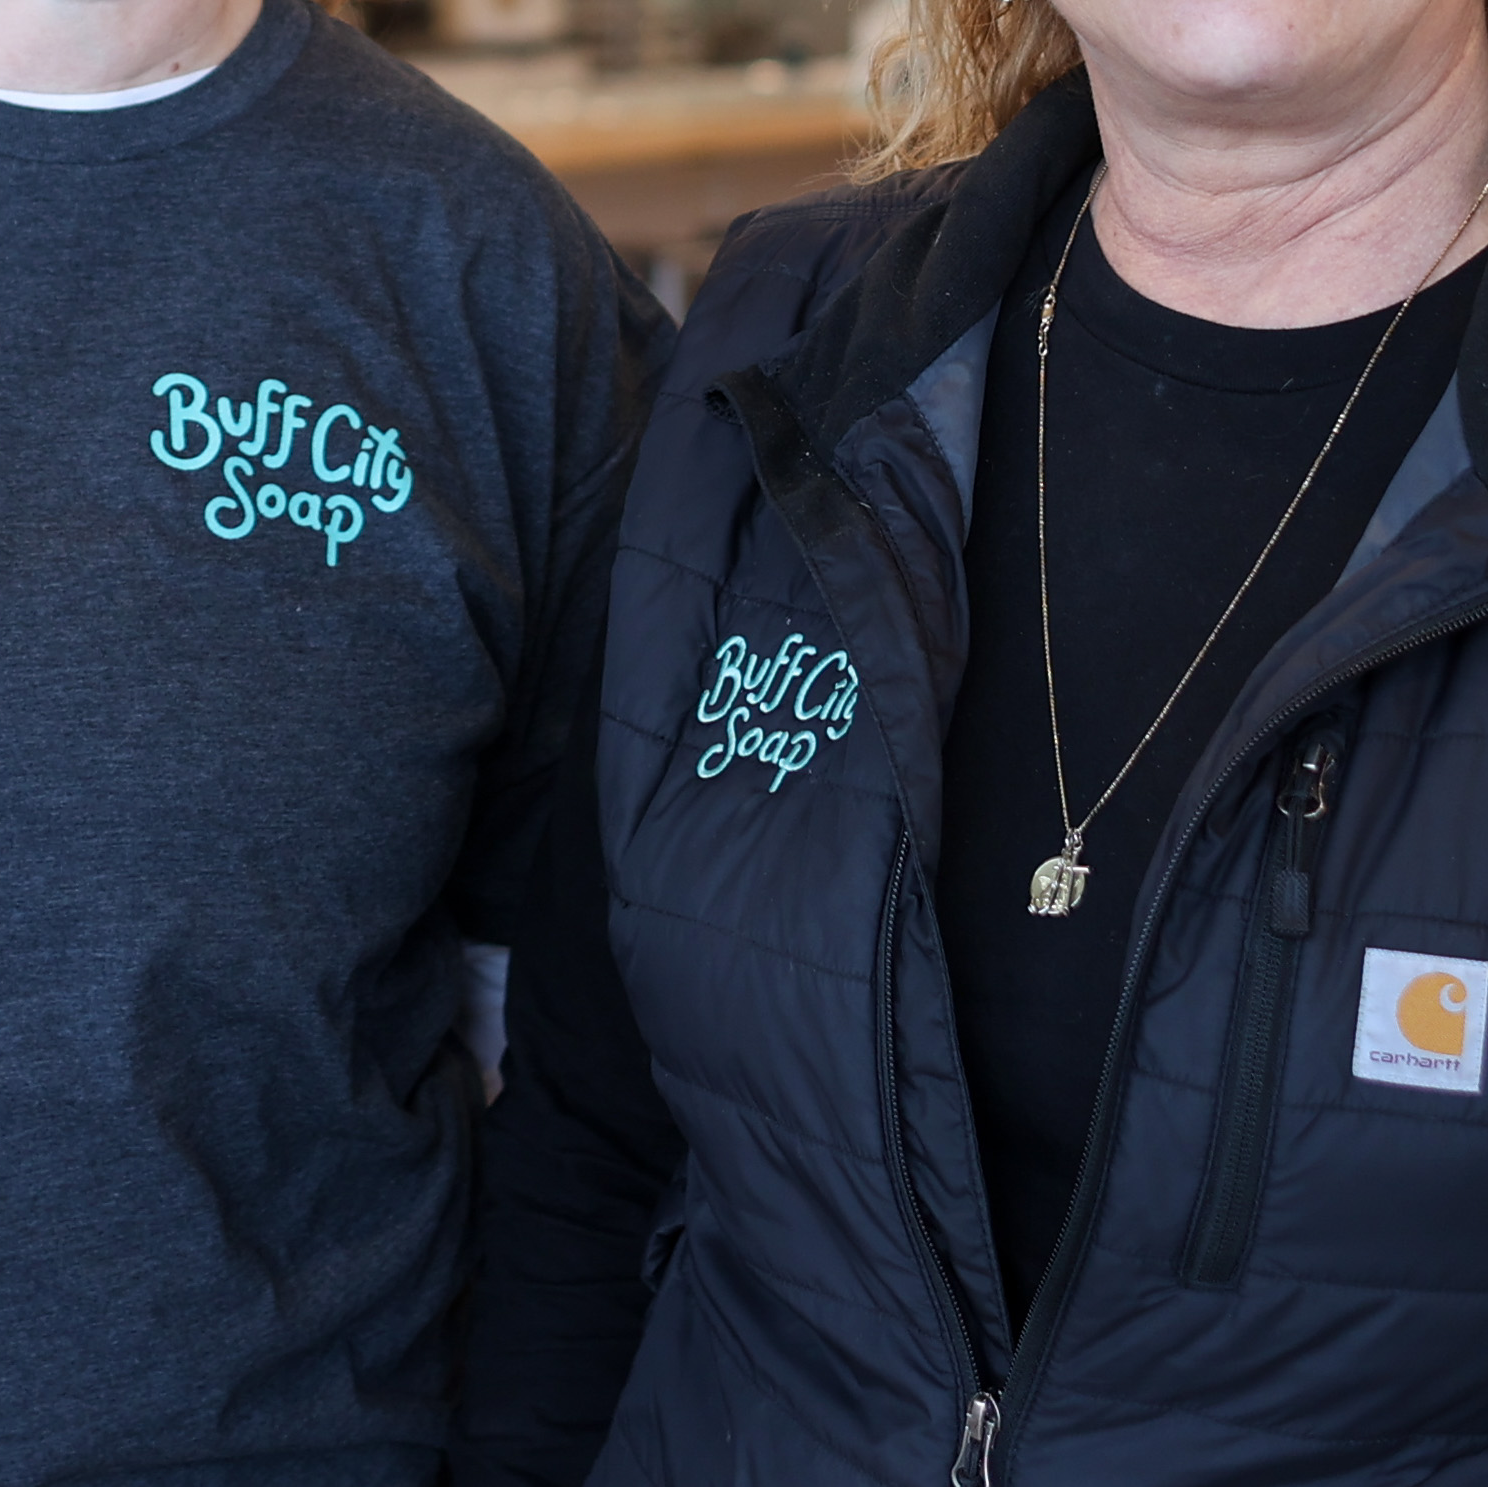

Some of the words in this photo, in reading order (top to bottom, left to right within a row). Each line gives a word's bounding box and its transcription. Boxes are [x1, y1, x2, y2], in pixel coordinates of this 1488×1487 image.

[150, 372, 314, 471] Buff
[312, 404, 413, 513] City
[204, 456, 365, 567] Soap
[697, 633, 817, 723] Buff
[794, 650, 858, 740] City
[696, 706, 817, 793] Soap
[1369, 1050, 1462, 1072] carhartt
